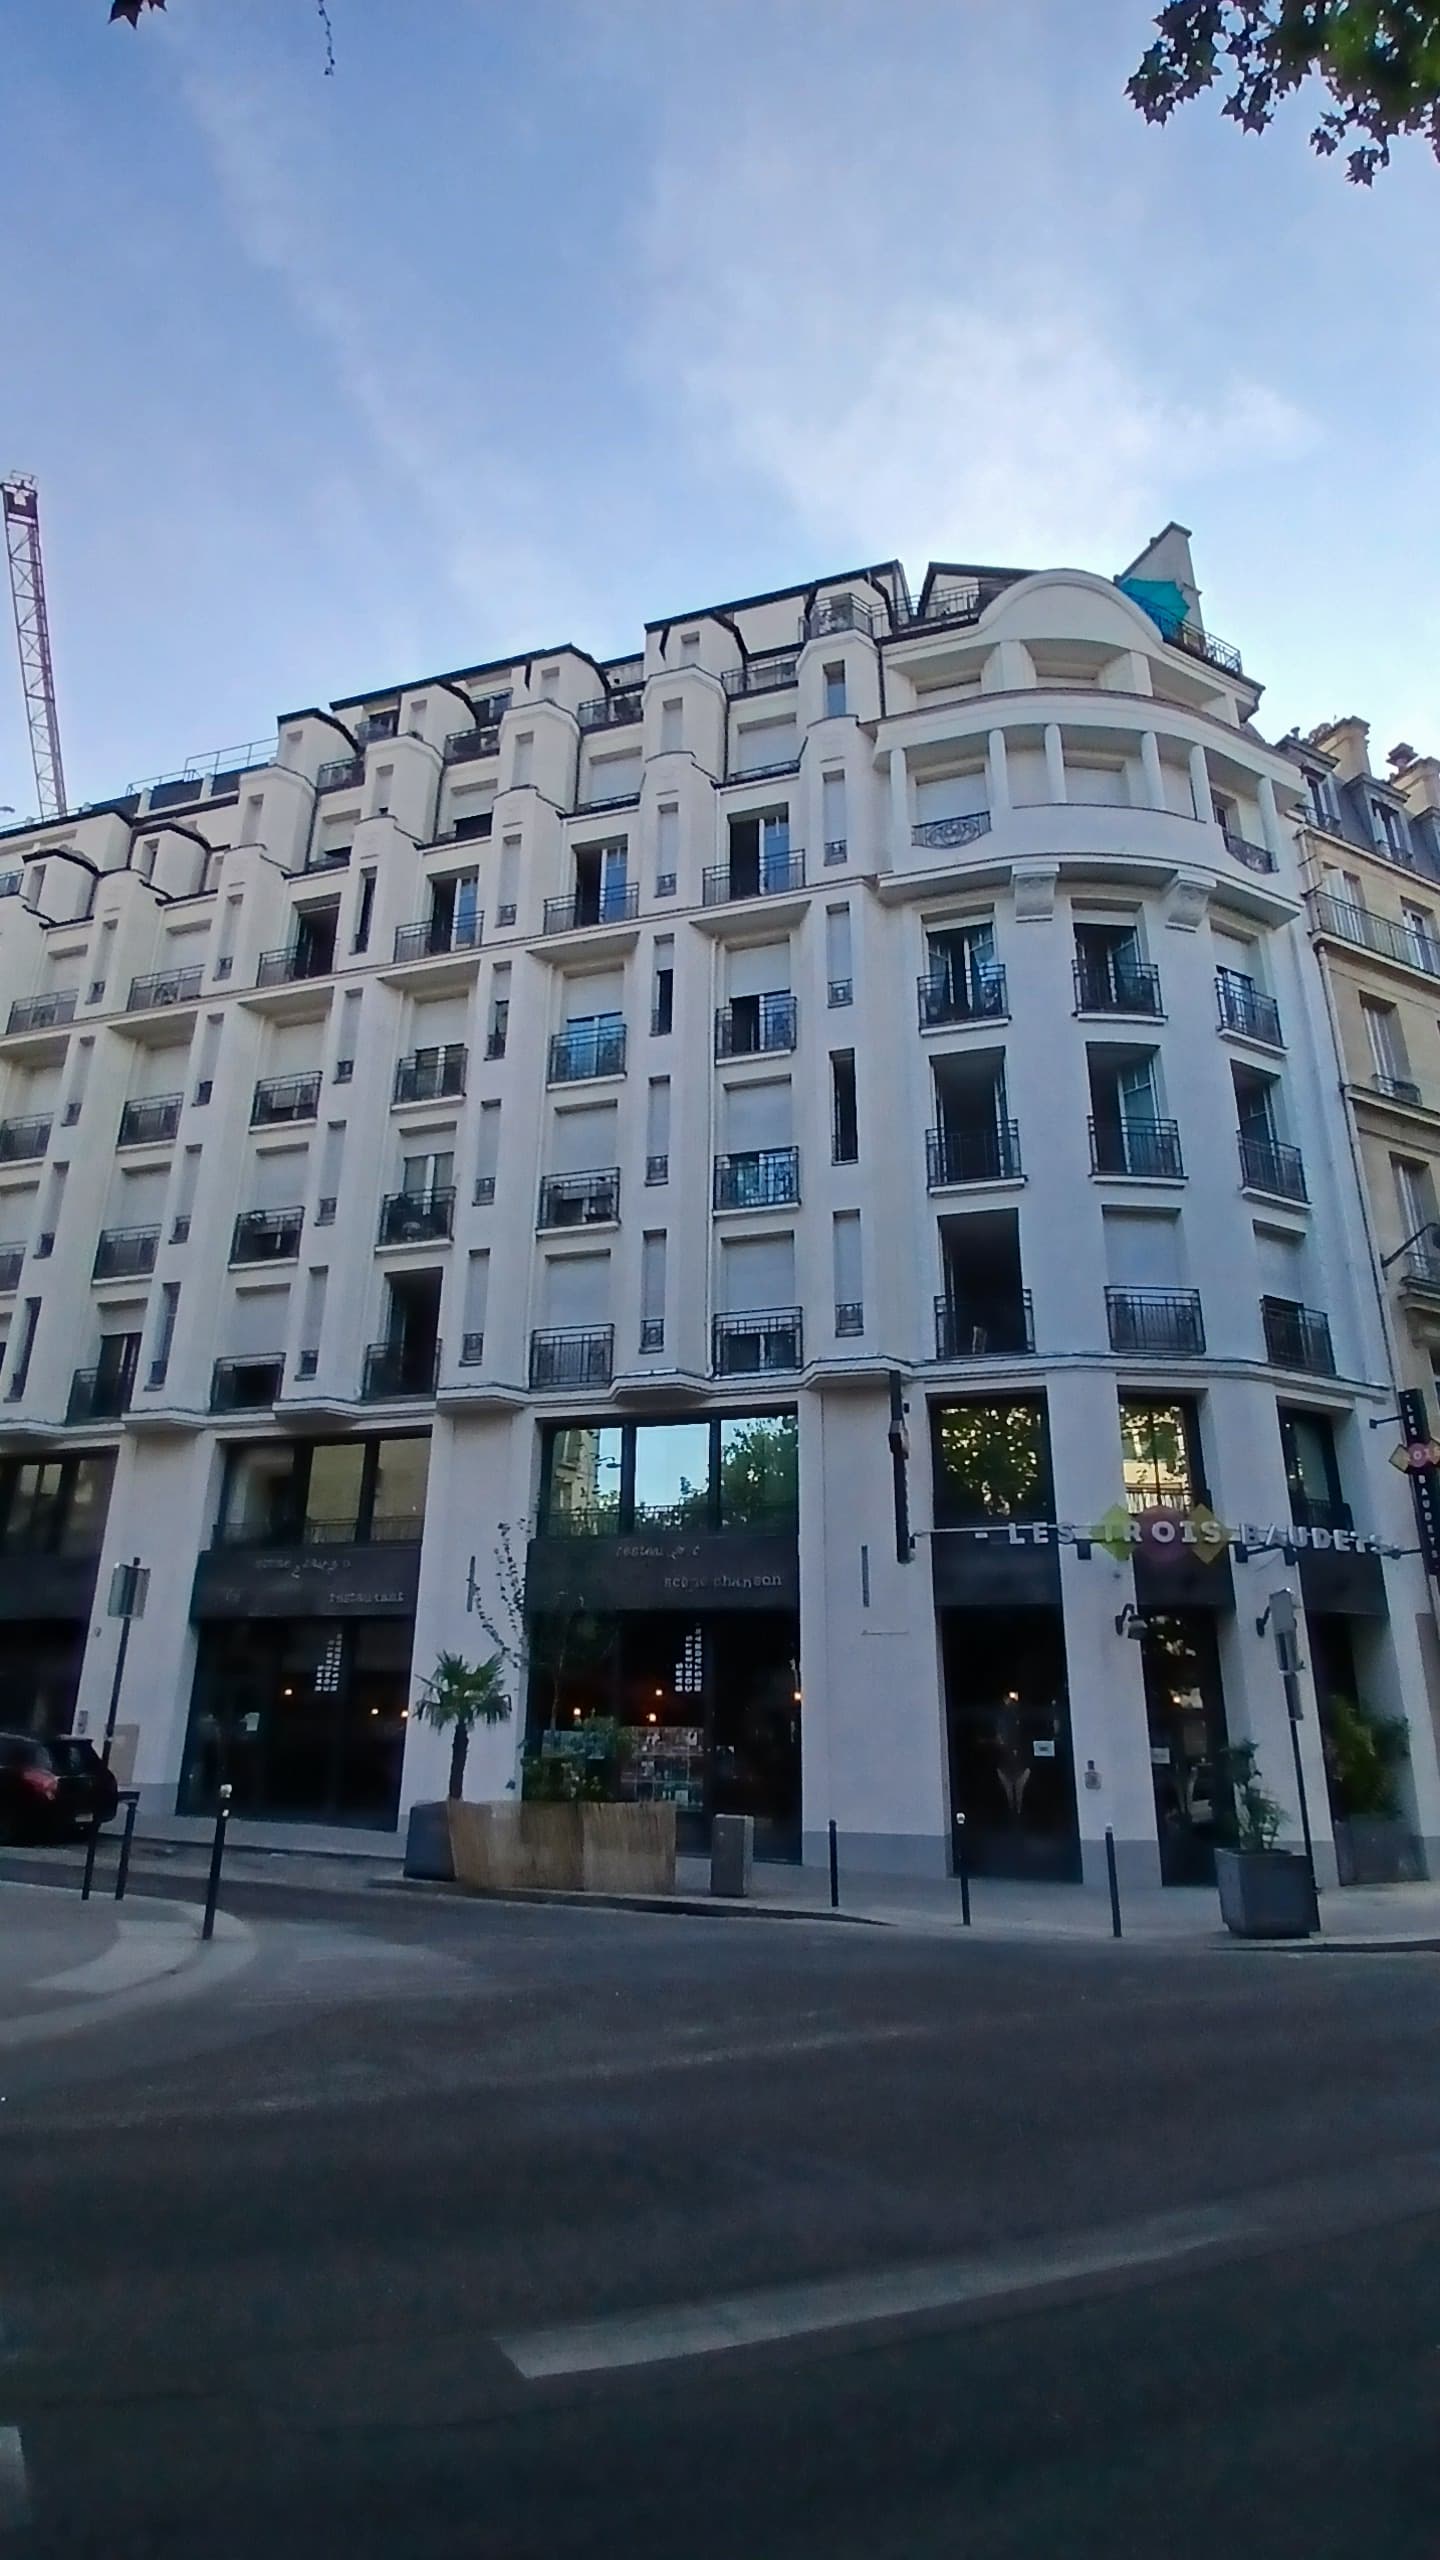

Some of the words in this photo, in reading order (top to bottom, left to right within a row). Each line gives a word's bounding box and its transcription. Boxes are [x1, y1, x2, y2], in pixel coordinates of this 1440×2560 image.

[1406, 1404, 1418, 1436] LES
[1008, 1521, 1075, 1544] LES
[1103, 1520, 1220, 1544] TROIS
[1418, 1474, 1439, 1558] BAUDETS
[616, 1545, 700, 1560] restaut
[694, 1622, 703, 1692] RESTAURAN
